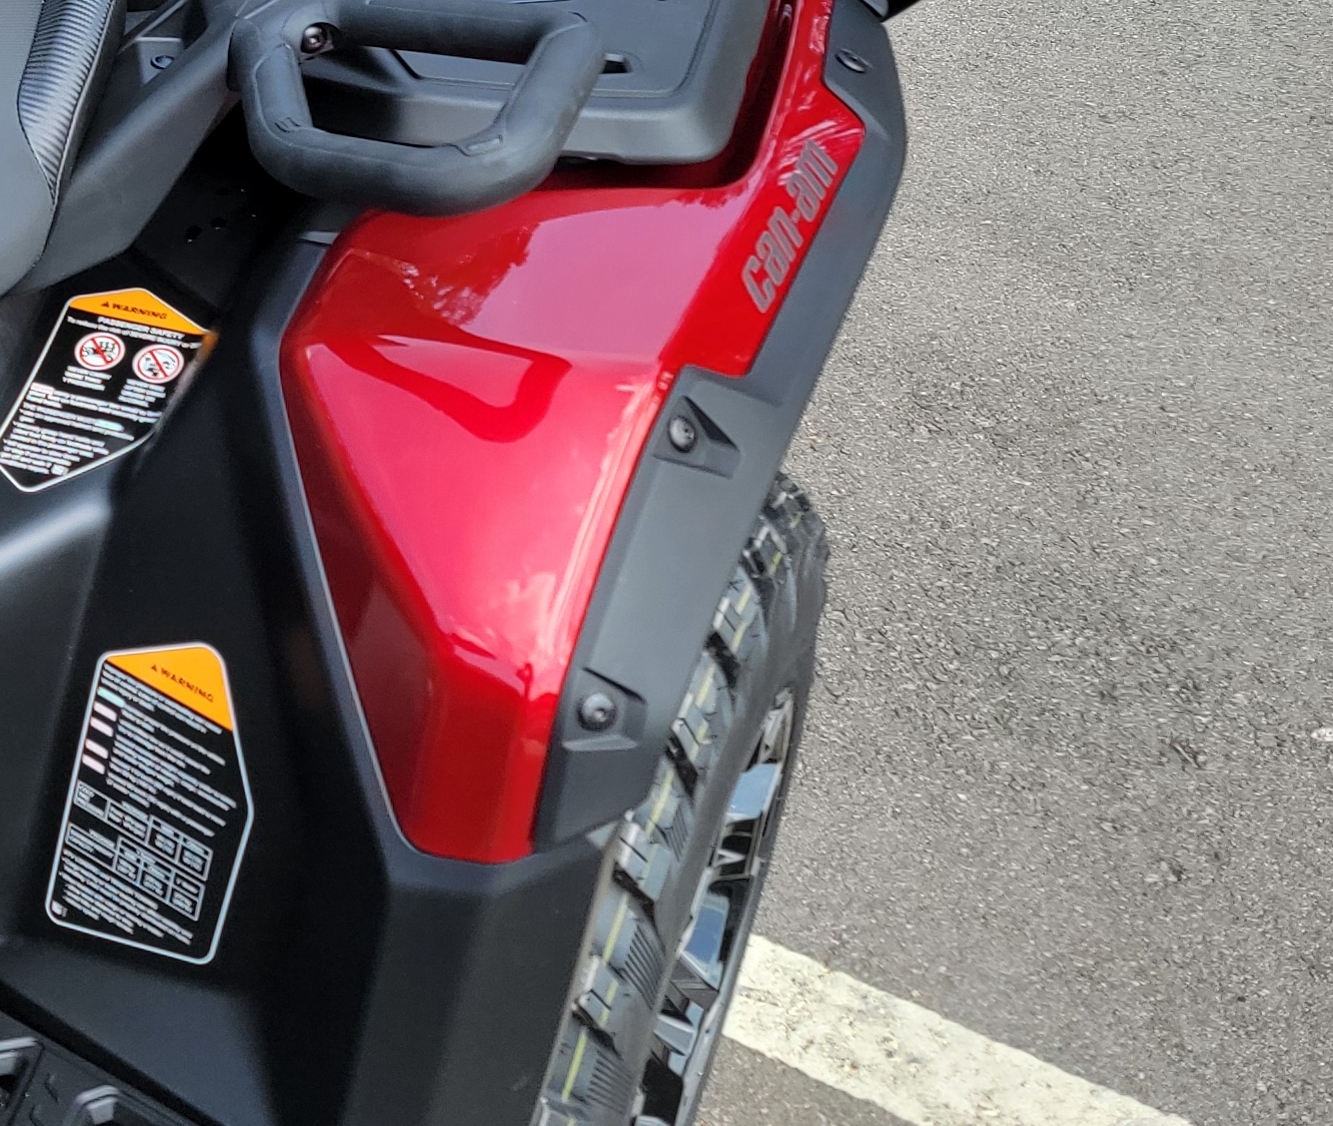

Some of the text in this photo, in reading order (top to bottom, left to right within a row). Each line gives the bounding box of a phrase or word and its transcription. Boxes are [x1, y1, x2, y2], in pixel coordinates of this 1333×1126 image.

[741, 138, 839, 314] can-am
[112, 302, 168, 320] WARNING
[159, 667, 214, 703] WARNING
